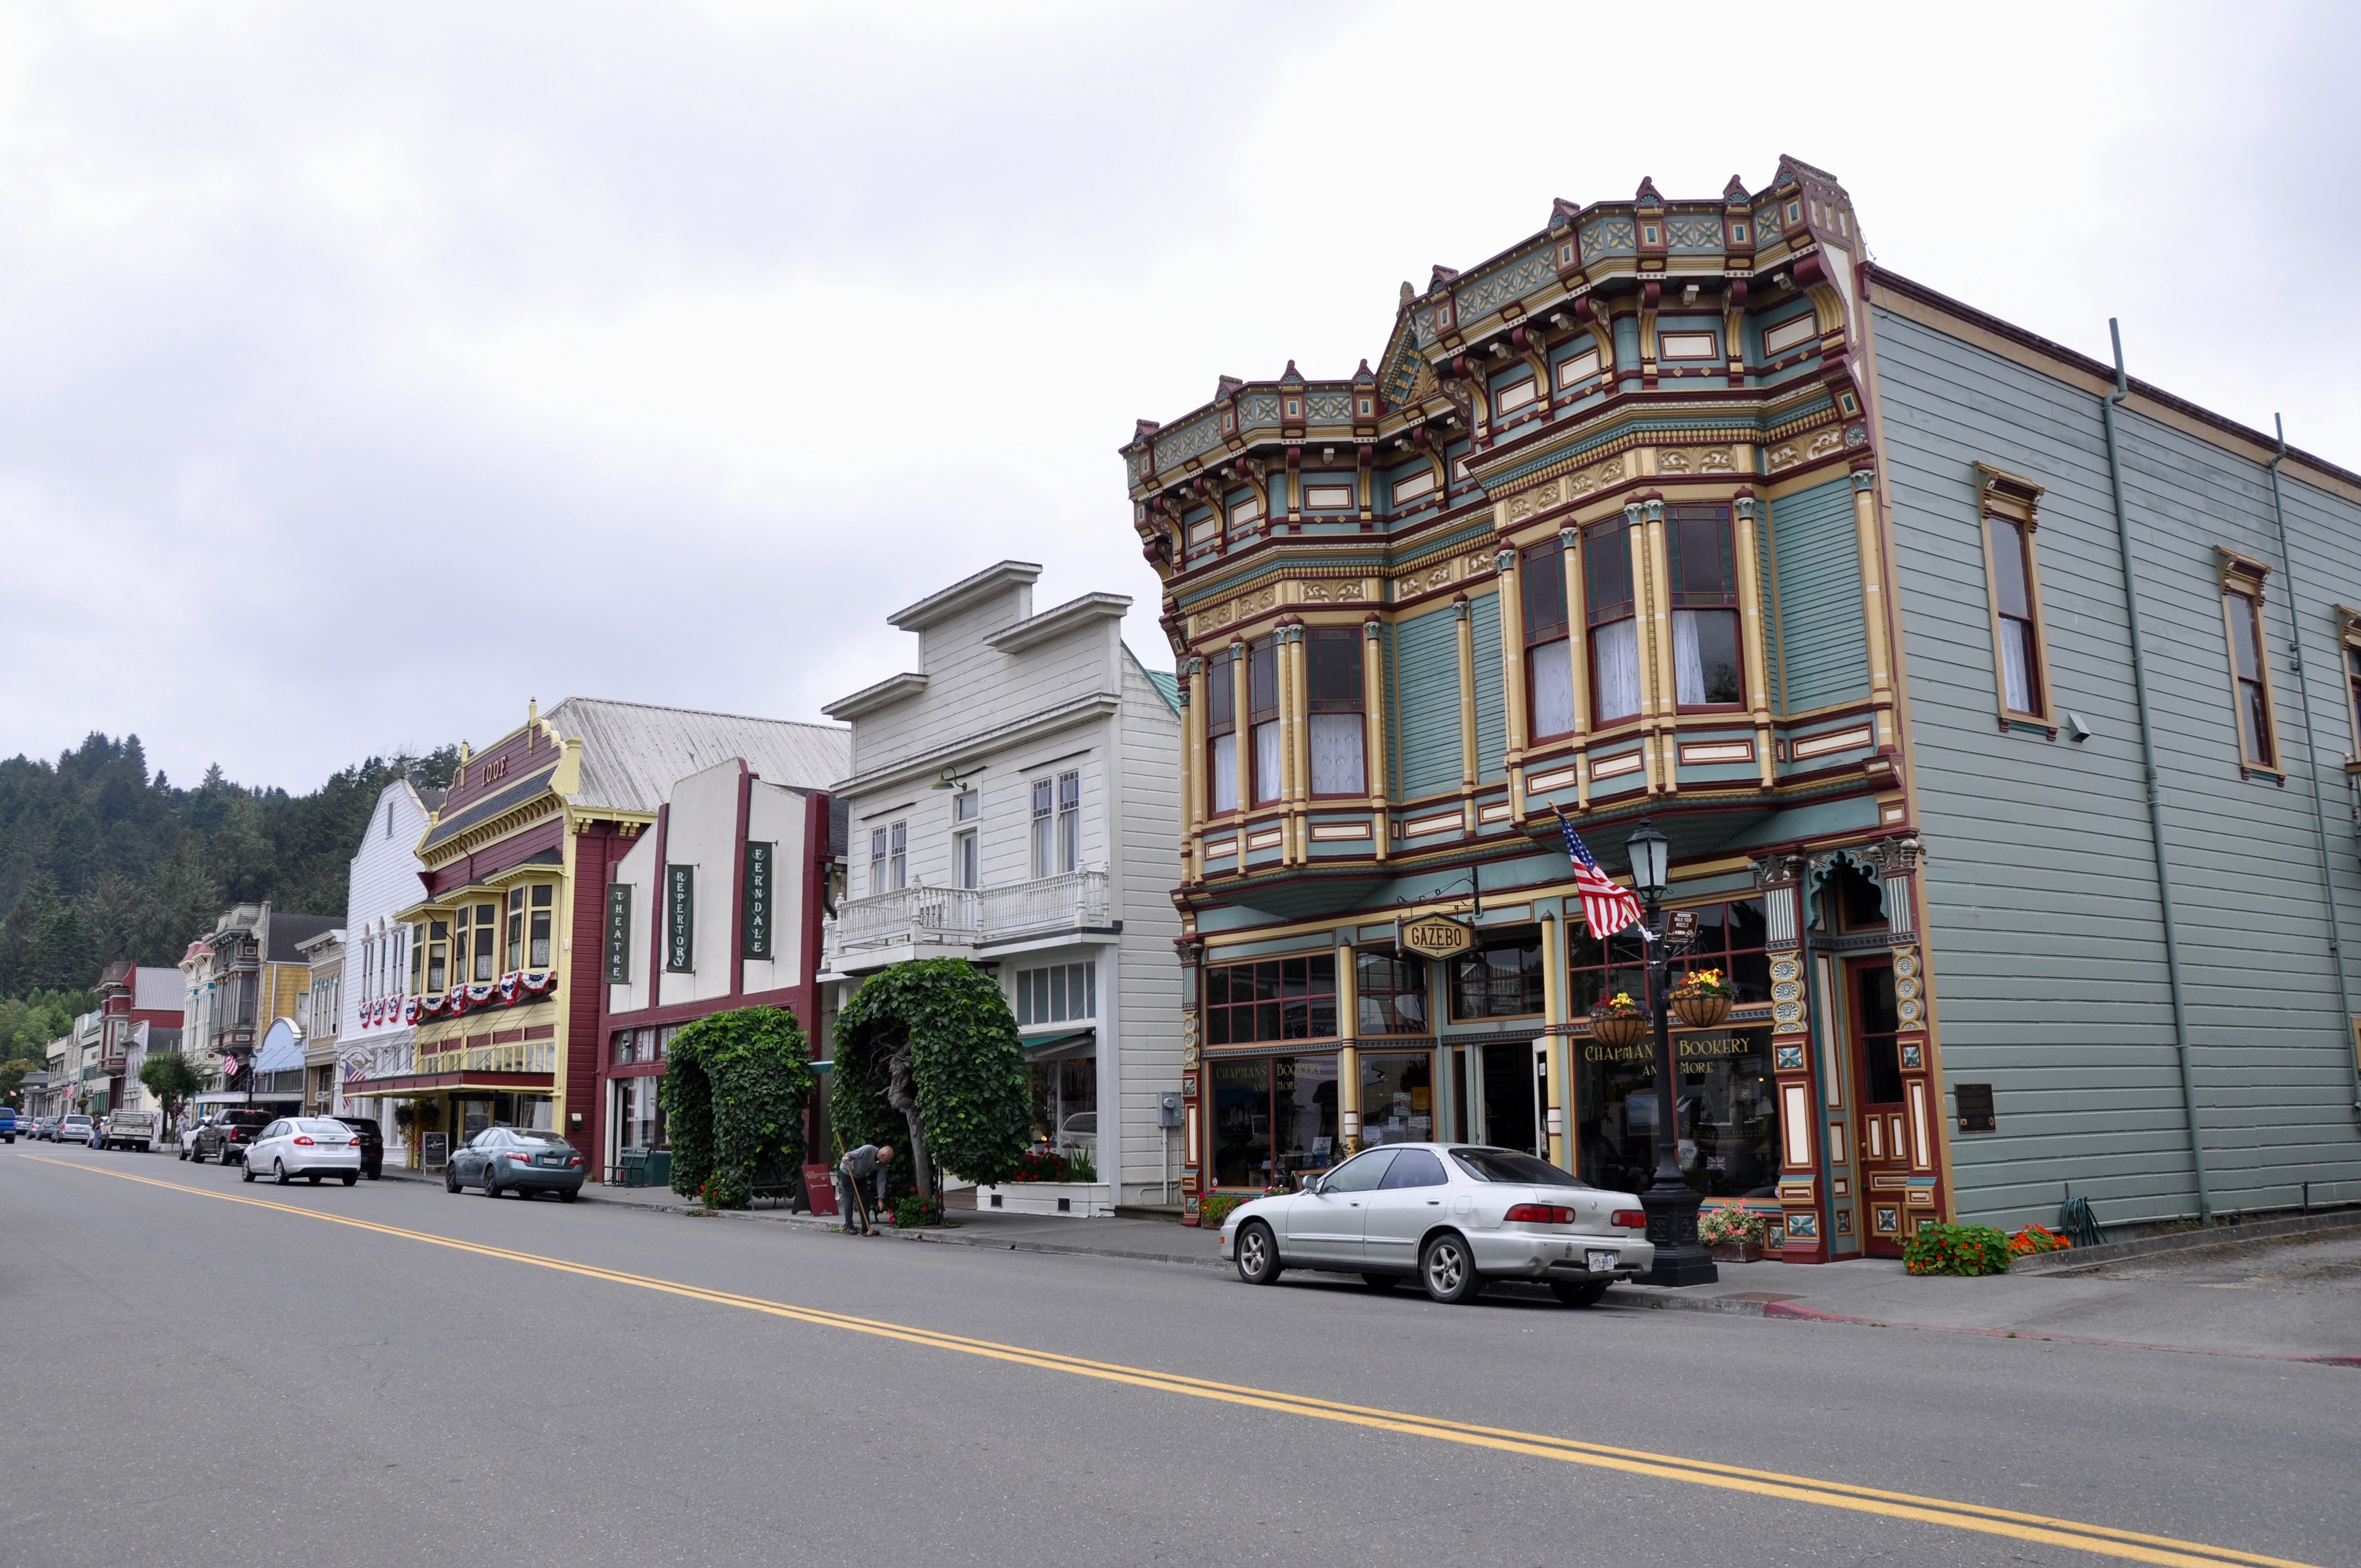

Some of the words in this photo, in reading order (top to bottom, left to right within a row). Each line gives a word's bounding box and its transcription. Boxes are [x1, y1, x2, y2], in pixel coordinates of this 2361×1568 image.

[753, 849, 763, 952] FERNDALE
[676, 872, 686, 967] REPERTORY
[613, 891, 623, 976] THEATRE
[1411, 927, 1462, 946] GAZEBO
[1585, 1042, 1655, 1061] CHAPMAN'
[1679, 1038, 1750, 1056] BOOKERY
[1216, 1065, 1266, 1079] CHAPMAN'S
[1277, 1063, 1321, 1076] BOOKERY
[1642, 1064, 1657, 1076] AN
[1680, 1061, 1713, 1074] MORE
[1253, 1083, 1266, 1092] AND
